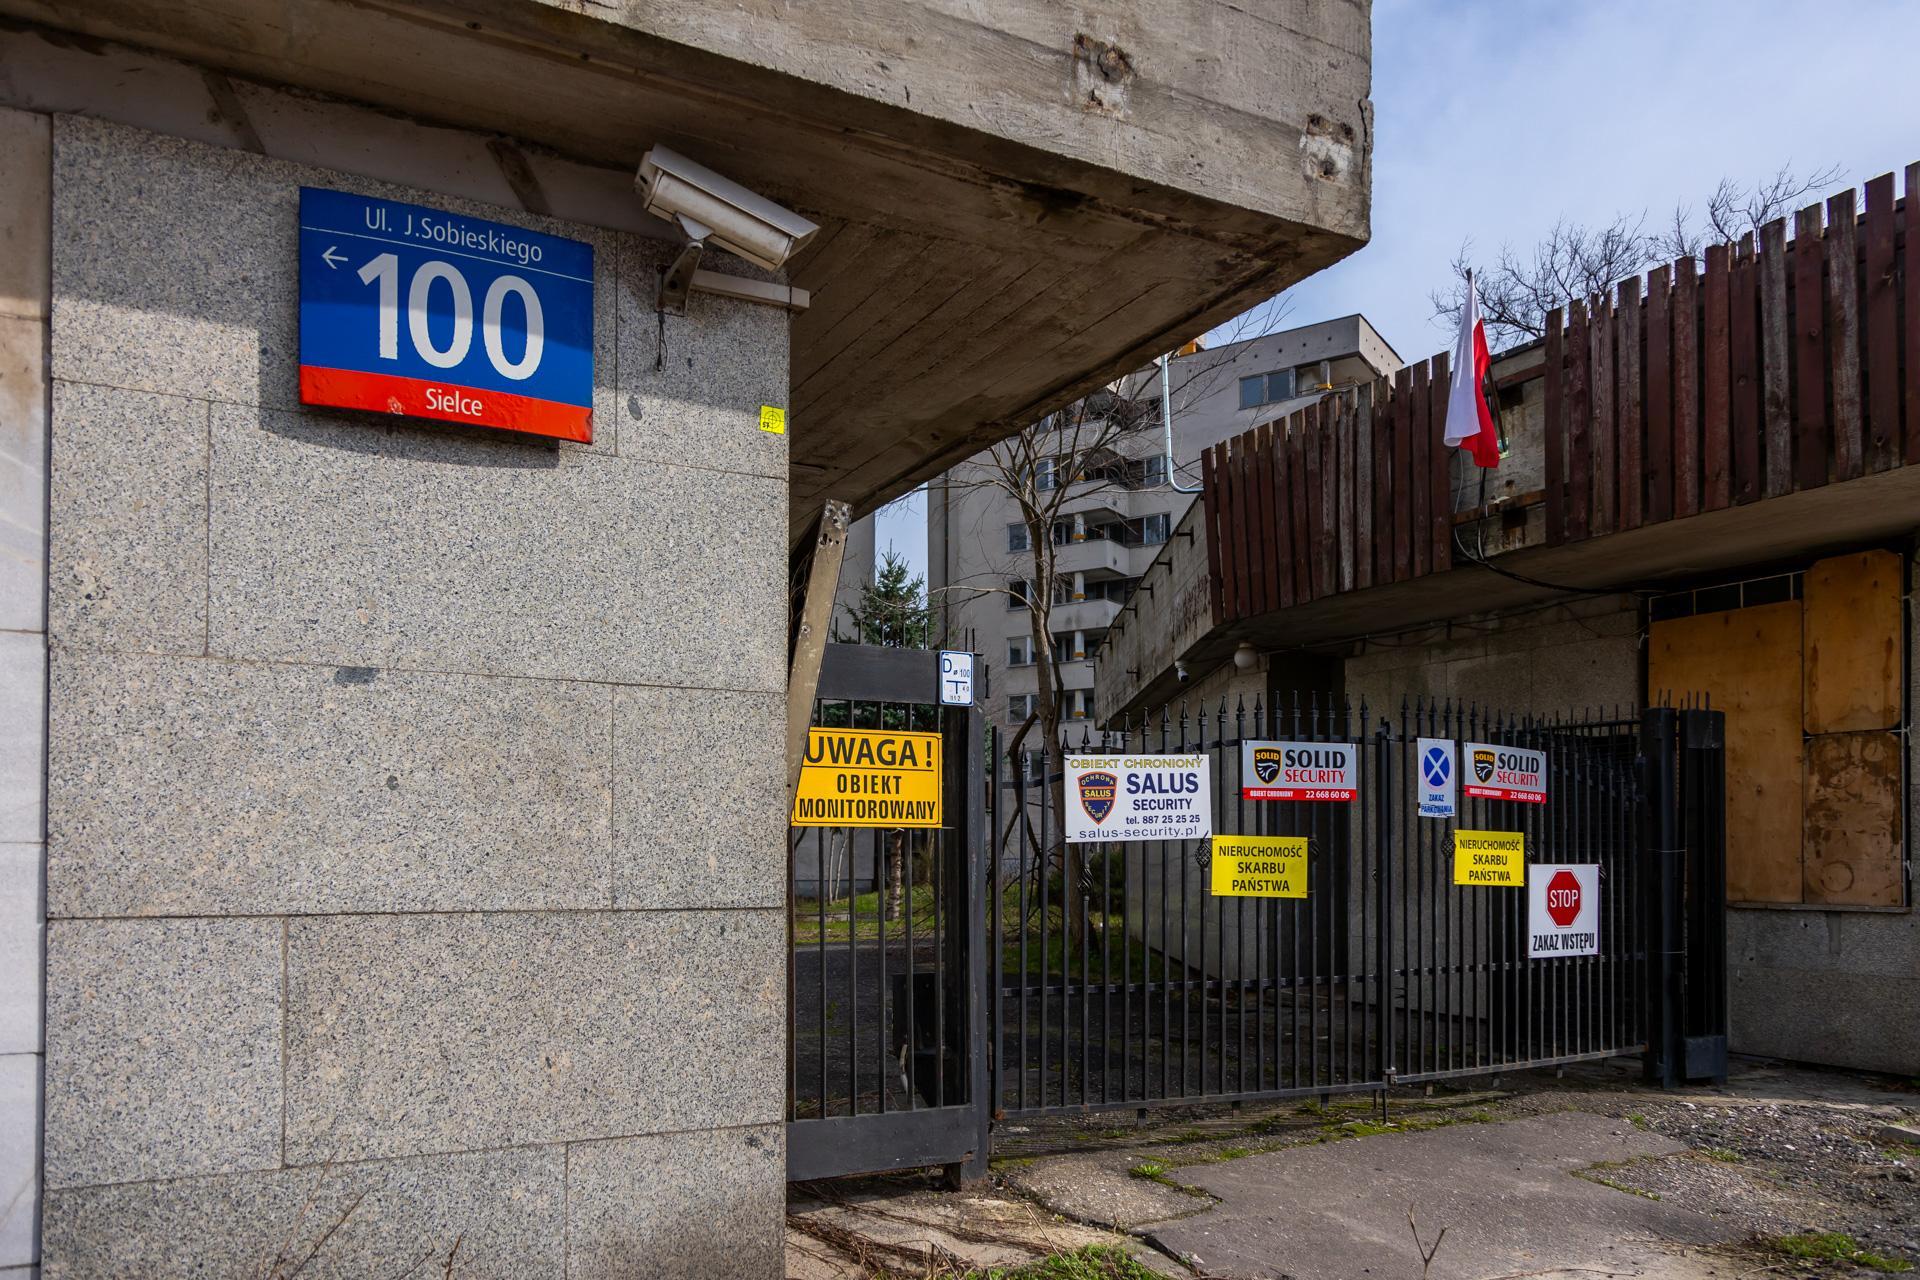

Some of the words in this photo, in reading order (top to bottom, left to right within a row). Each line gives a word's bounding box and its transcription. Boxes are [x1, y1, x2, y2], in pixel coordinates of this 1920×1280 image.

[365, 206, 392, 232] Ul.
[404, 214, 542, 265] J.Sobieskiego
[357, 252, 545, 381] 100
[425, 388, 483, 417] Sielce
[942, 658, 952, 673] D
[805, 735, 917, 767] UWAGA
[1256, 751, 1279, 760] SOLID
[1475, 753, 1494, 762] SOLID
[1070, 758, 1120, 769] OBIEKT
[1123, 758, 1203, 769] CHRONIONY
[1285, 749, 1346, 769] SOLID
[1498, 752, 1540, 773] SOLID
[1081, 774, 1115, 786] OCHRONA
[1284, 769, 1345, 783] SECURITY
[1497, 770, 1539, 787] SECURITY
[837, 774, 902, 794] OBIEKT
[1126, 772, 1199, 795] SALUS
[1085, 789, 1111, 798] SALUS
[1306, 790, 1315, 798] 22
[1330, 791, 1339, 799] 60
[1340, 791, 1350, 799] 06
[799, 798, 936, 820] MONITOROWANY
[1085, 801, 1110, 818] SECURITY
[1133, 798, 1192, 811] SECURITY
[1126, 816, 1139, 825] tel.
[1142, 815, 1159, 824] 887
[1162, 815, 1173, 824] 25
[1176, 814, 1187, 823] 25
[1189, 814, 1200, 823] 25
[1079, 826, 1197, 839] salus-security.pl
[1219, 844, 1303, 858] NIERUCHOMOŚĆ
[1459, 839, 1520, 851] NIERUCHOMOŚĆ
[1473, 854, 1508, 866] SKARBU
[1237, 862, 1286, 874] SKARBU
[1468, 868, 1511, 881] PAŃSTWA
[1232, 876, 1290, 892] PAŃSTWA
[1549, 889, 1579, 908] STOP
[1533, 934, 1559, 951] ZAKAZ
[1561, 932, 1595, 953] WSTĘPU
